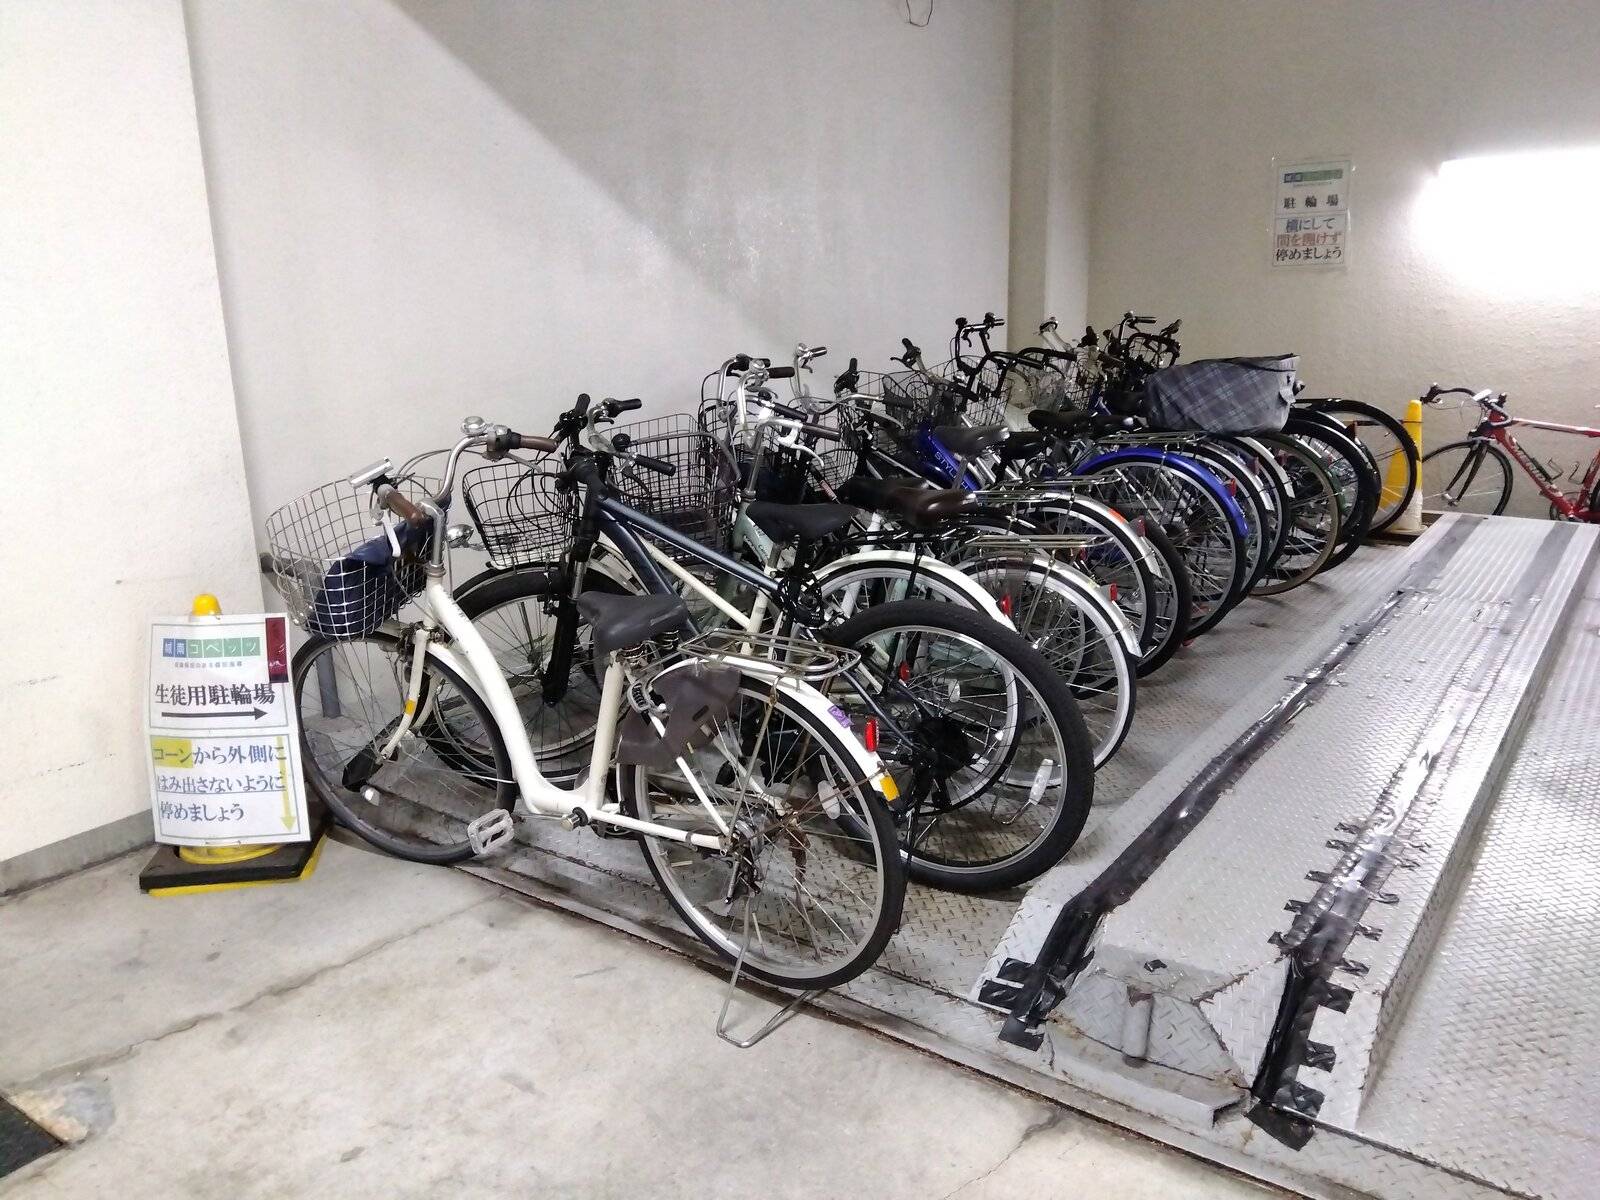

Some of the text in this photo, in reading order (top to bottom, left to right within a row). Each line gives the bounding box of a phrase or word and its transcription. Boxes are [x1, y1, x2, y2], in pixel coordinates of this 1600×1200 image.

[1276, 246, 1342, 262] 停めましょう
[155, 682, 276, 706] 生徒用駐輪場
[154, 744, 287, 766] コーンから外側に
[156, 774, 286, 794] はみ出さないように
[160, 800, 245, 822] 停めましょう
